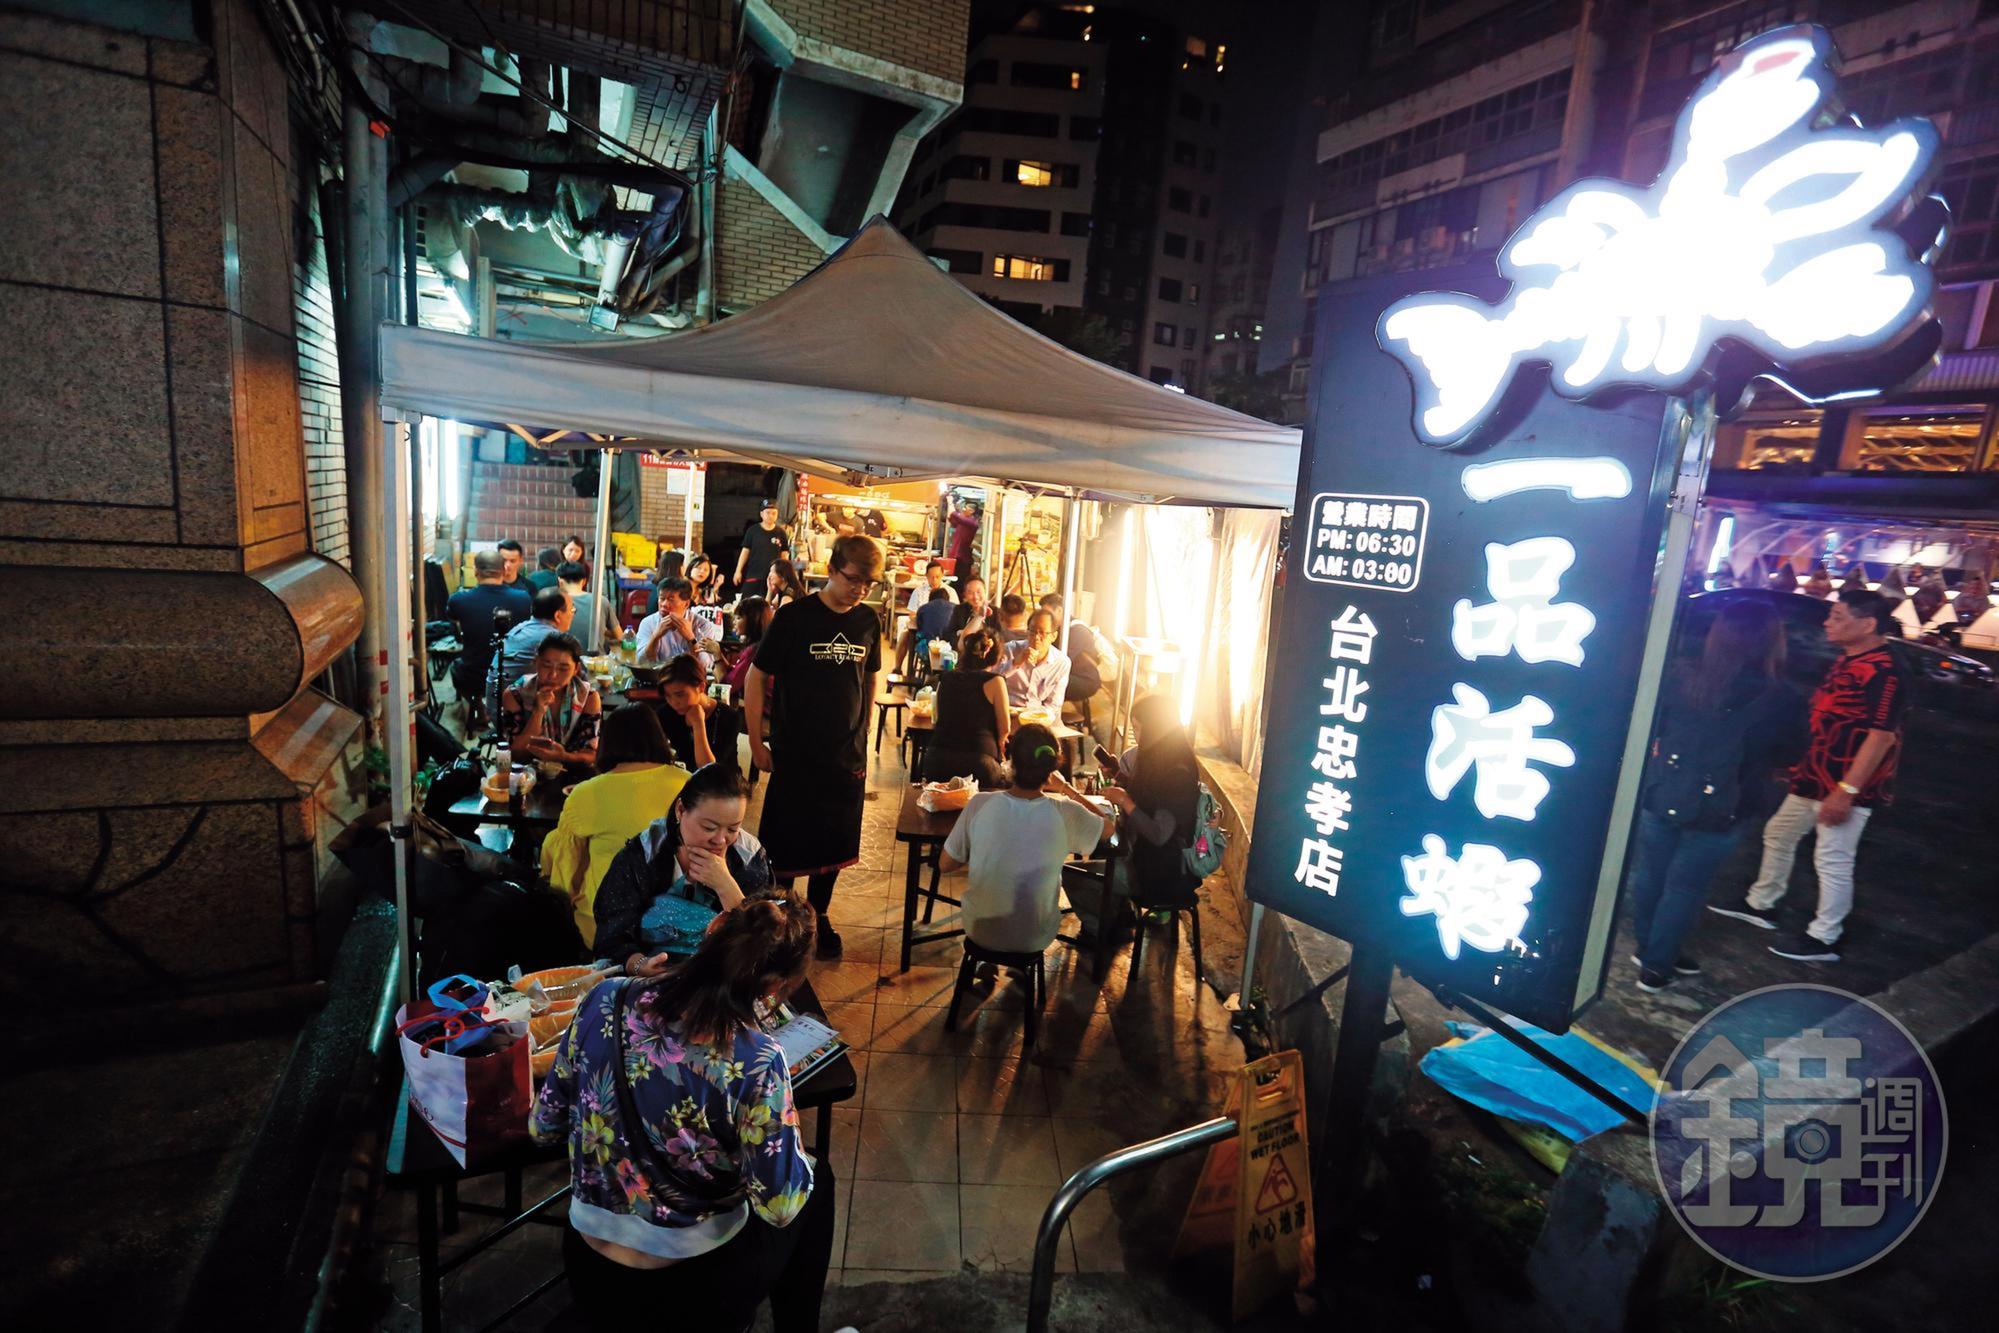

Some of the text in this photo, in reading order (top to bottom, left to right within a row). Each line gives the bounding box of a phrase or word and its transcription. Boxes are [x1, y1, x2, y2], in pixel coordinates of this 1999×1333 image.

[1322, 500, 1418, 531] 營業時間
[1317, 528, 1416, 556] PM: 06:30
[1311, 554, 1349, 576] AM:
[1294, 604, 1379, 896] 台北忠孝店
